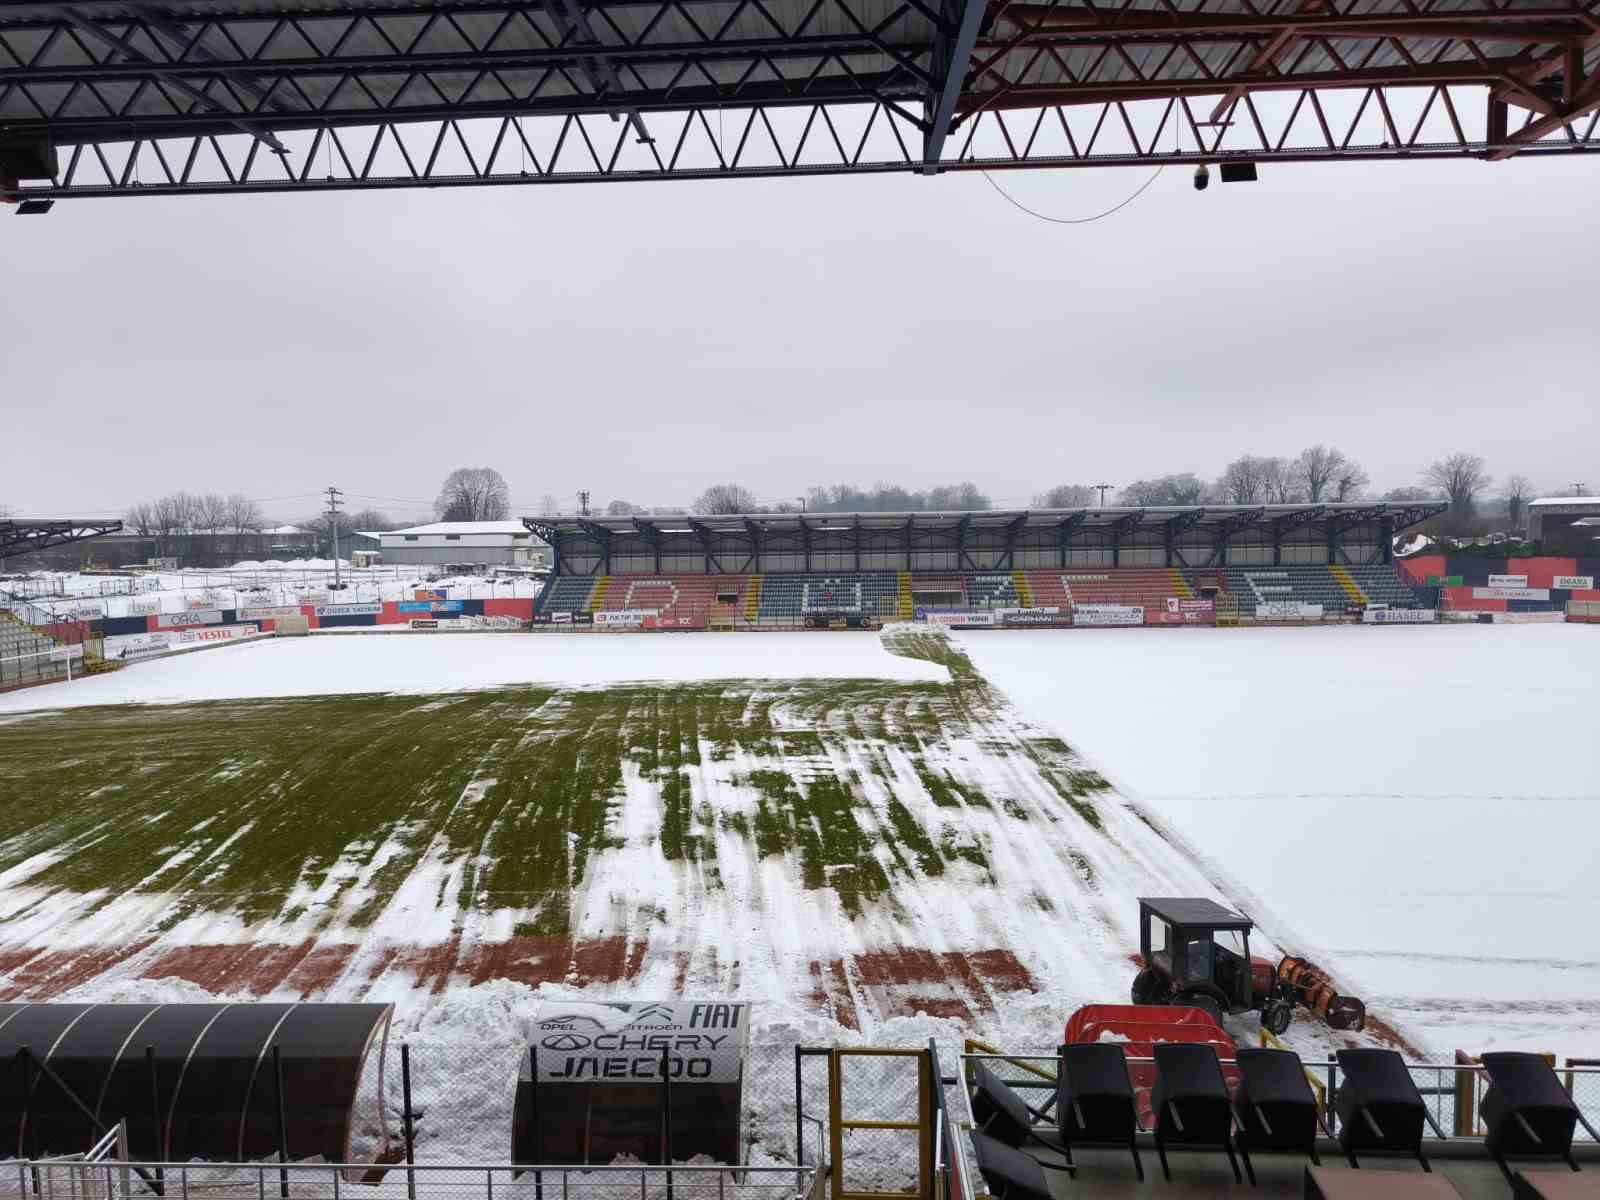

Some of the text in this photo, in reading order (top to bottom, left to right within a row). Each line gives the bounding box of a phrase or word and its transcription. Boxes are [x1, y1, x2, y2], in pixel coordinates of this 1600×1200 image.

[197, 630, 233, 642] VESTEL
[689, 1003, 745, 1029] FIAT
[541, 1023, 577, 1031] OPEL
[594, 1034, 729, 1051] CHERY
